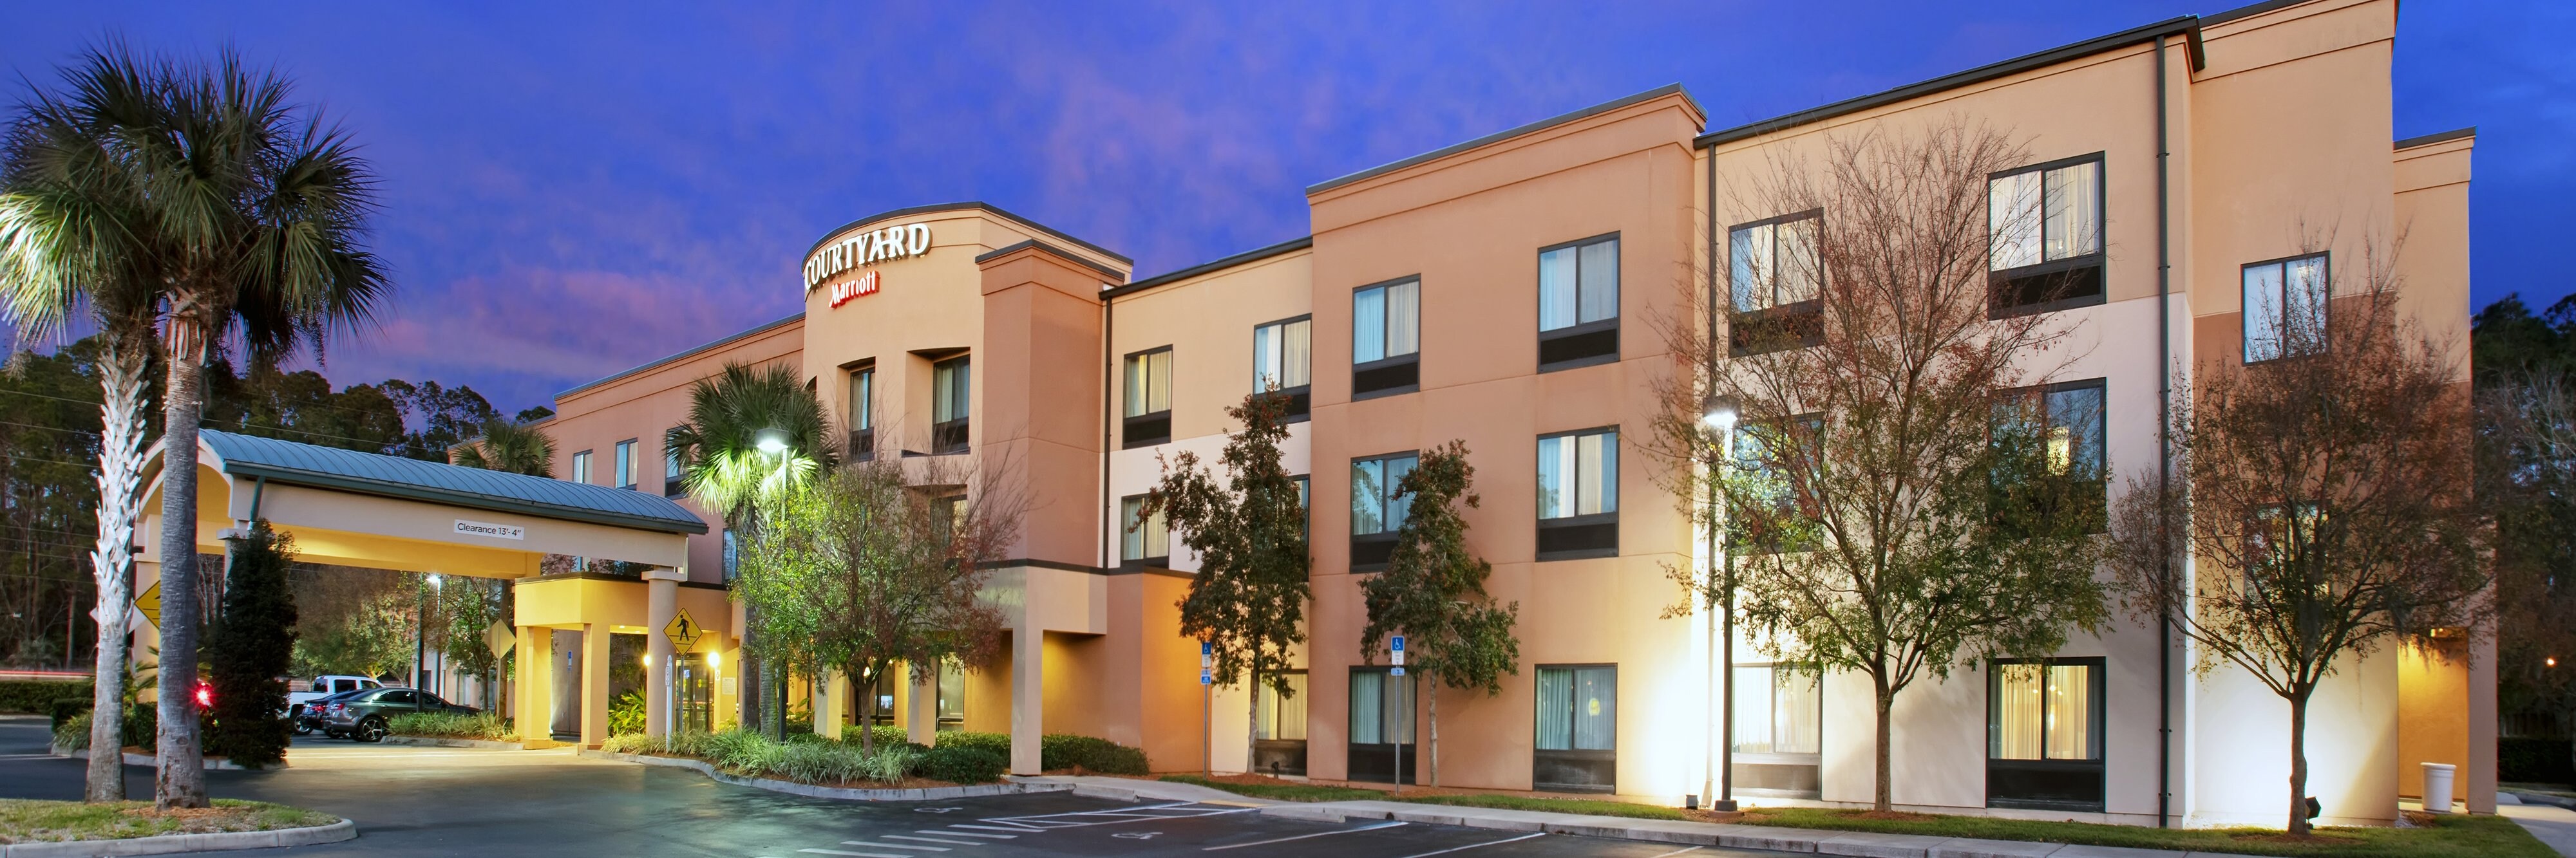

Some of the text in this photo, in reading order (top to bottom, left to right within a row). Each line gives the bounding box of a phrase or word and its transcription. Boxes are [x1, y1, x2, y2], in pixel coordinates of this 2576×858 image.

[804, 223, 931, 290] COURTYARD
[829, 271, 877, 308] Marriott
[457, 523, 497, 534] Clearance
